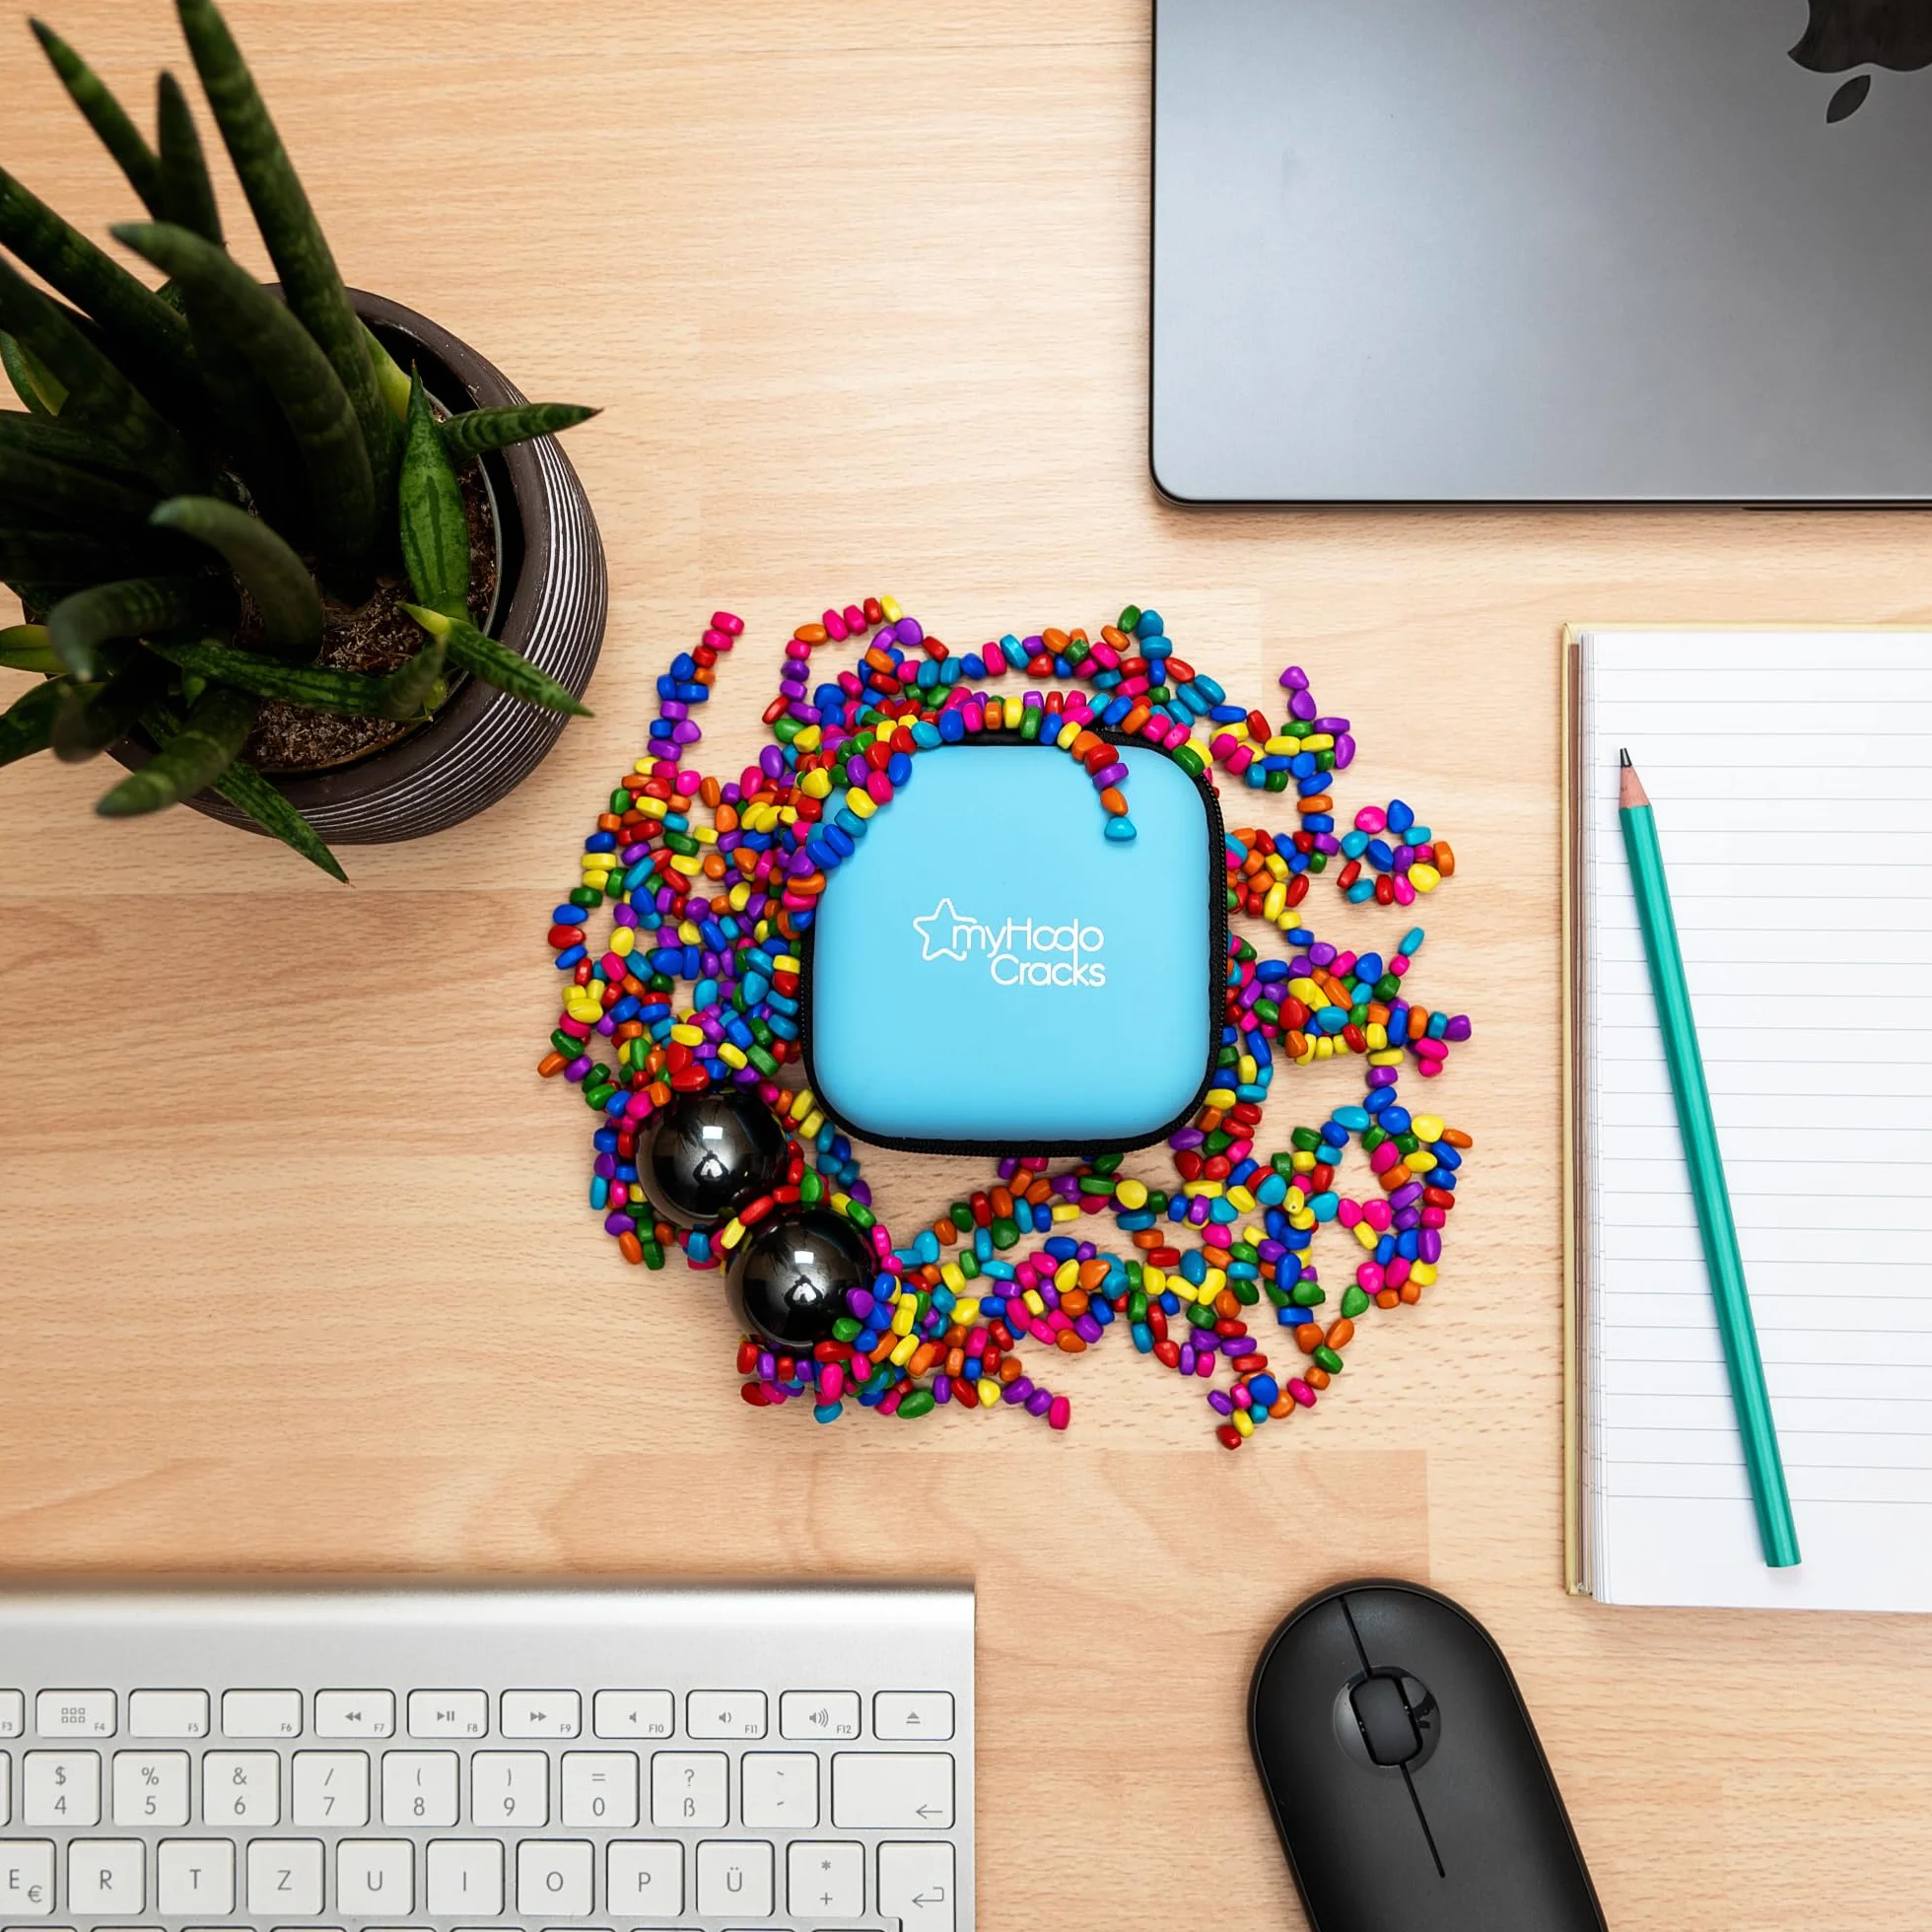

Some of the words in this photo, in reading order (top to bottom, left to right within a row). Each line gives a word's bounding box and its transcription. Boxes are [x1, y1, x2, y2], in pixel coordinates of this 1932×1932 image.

[991, 953, 1106, 987] Cracks
[94, 1722, 105, 1731] F4
[187, 1722, 199, 1733] F5
[281, 1722, 293, 1732] F6
[374, 1723, 385, 1733] F7
[466, 1723, 478, 1733] F8
[560, 1723, 572, 1733] F9
[649, 1723, 664, 1734] F10
[744, 1724, 758, 1734] F11
[836, 1724, 852, 1735] F12
[54, 1765, 67, 1786] $
[141, 1766, 160, 1786] %
[232, 1766, 247, 1786] &
[684, 1768, 695, 1787] ?
[53, 1795, 67, 1815] 4
[144, 1795, 157, 1816] 5
[234, 1795, 246, 1816] 6
[323, 1796, 335, 1817] 7
[413, 1796, 426, 1817] 8
[503, 1797, 516, 1817] 9
[591, 1797, 605, 1817] 0
[9, 1868, 21, 1890] E
[100, 1869, 112, 1890] R
[189, 1868, 202, 1890] T
[277, 1870, 292, 1891] Z
[367, 1870, 383, 1892] U
[545, 1871, 564, 1893] O
[638, 1871, 652, 1893] P
[726, 1866, 743, 1893] Ü
[27, 1885, 42, 1903] €
[819, 1892, 833, 1905] +
